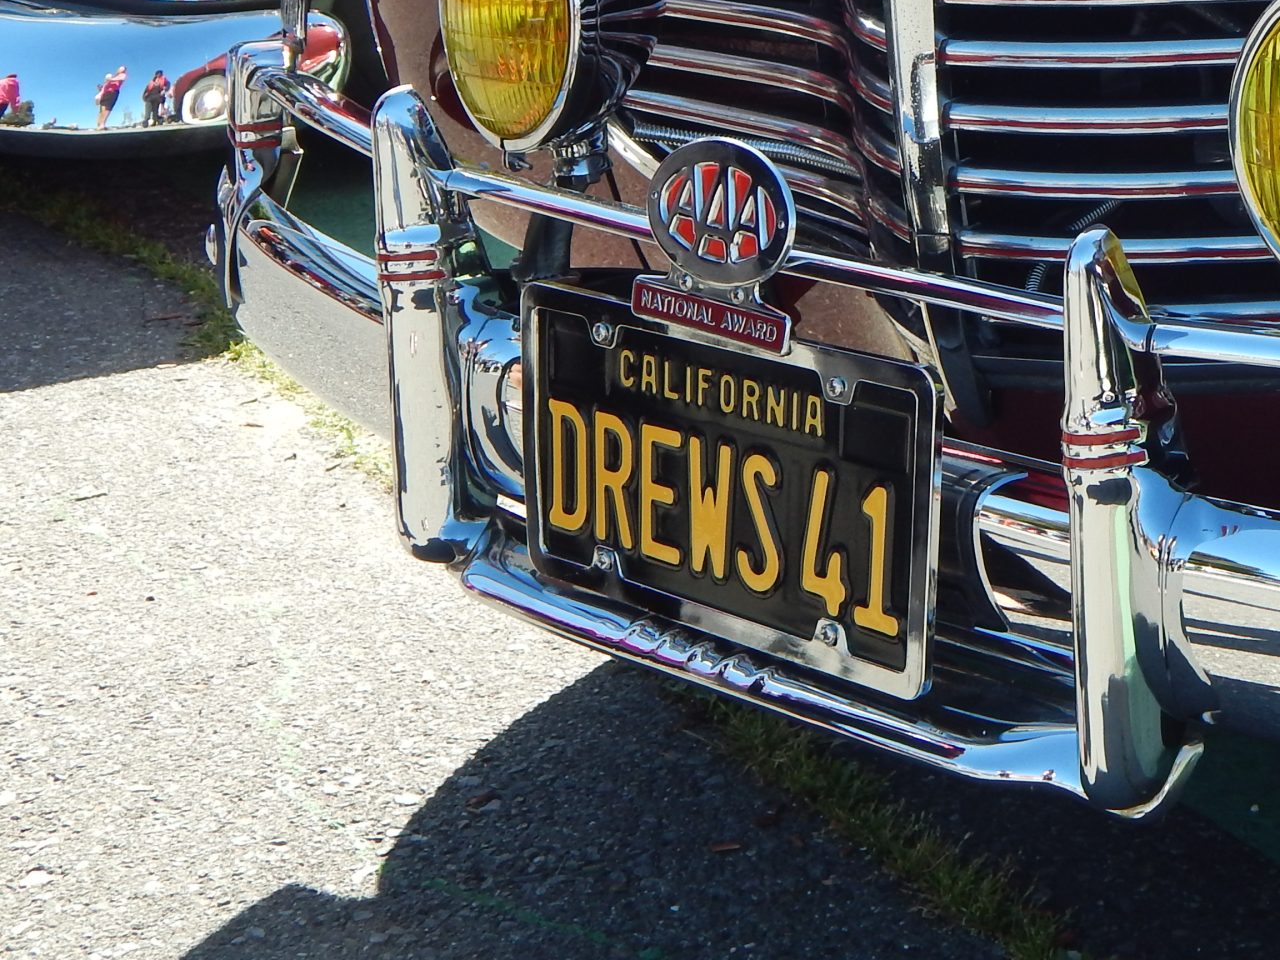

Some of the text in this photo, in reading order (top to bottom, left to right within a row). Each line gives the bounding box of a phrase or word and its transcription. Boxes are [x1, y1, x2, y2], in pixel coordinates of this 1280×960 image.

[658, 161, 777, 264] AAA
[640, 288, 777, 343] NATIONAL AWARD
[619, 349, 825, 437] CALIFORNIA
